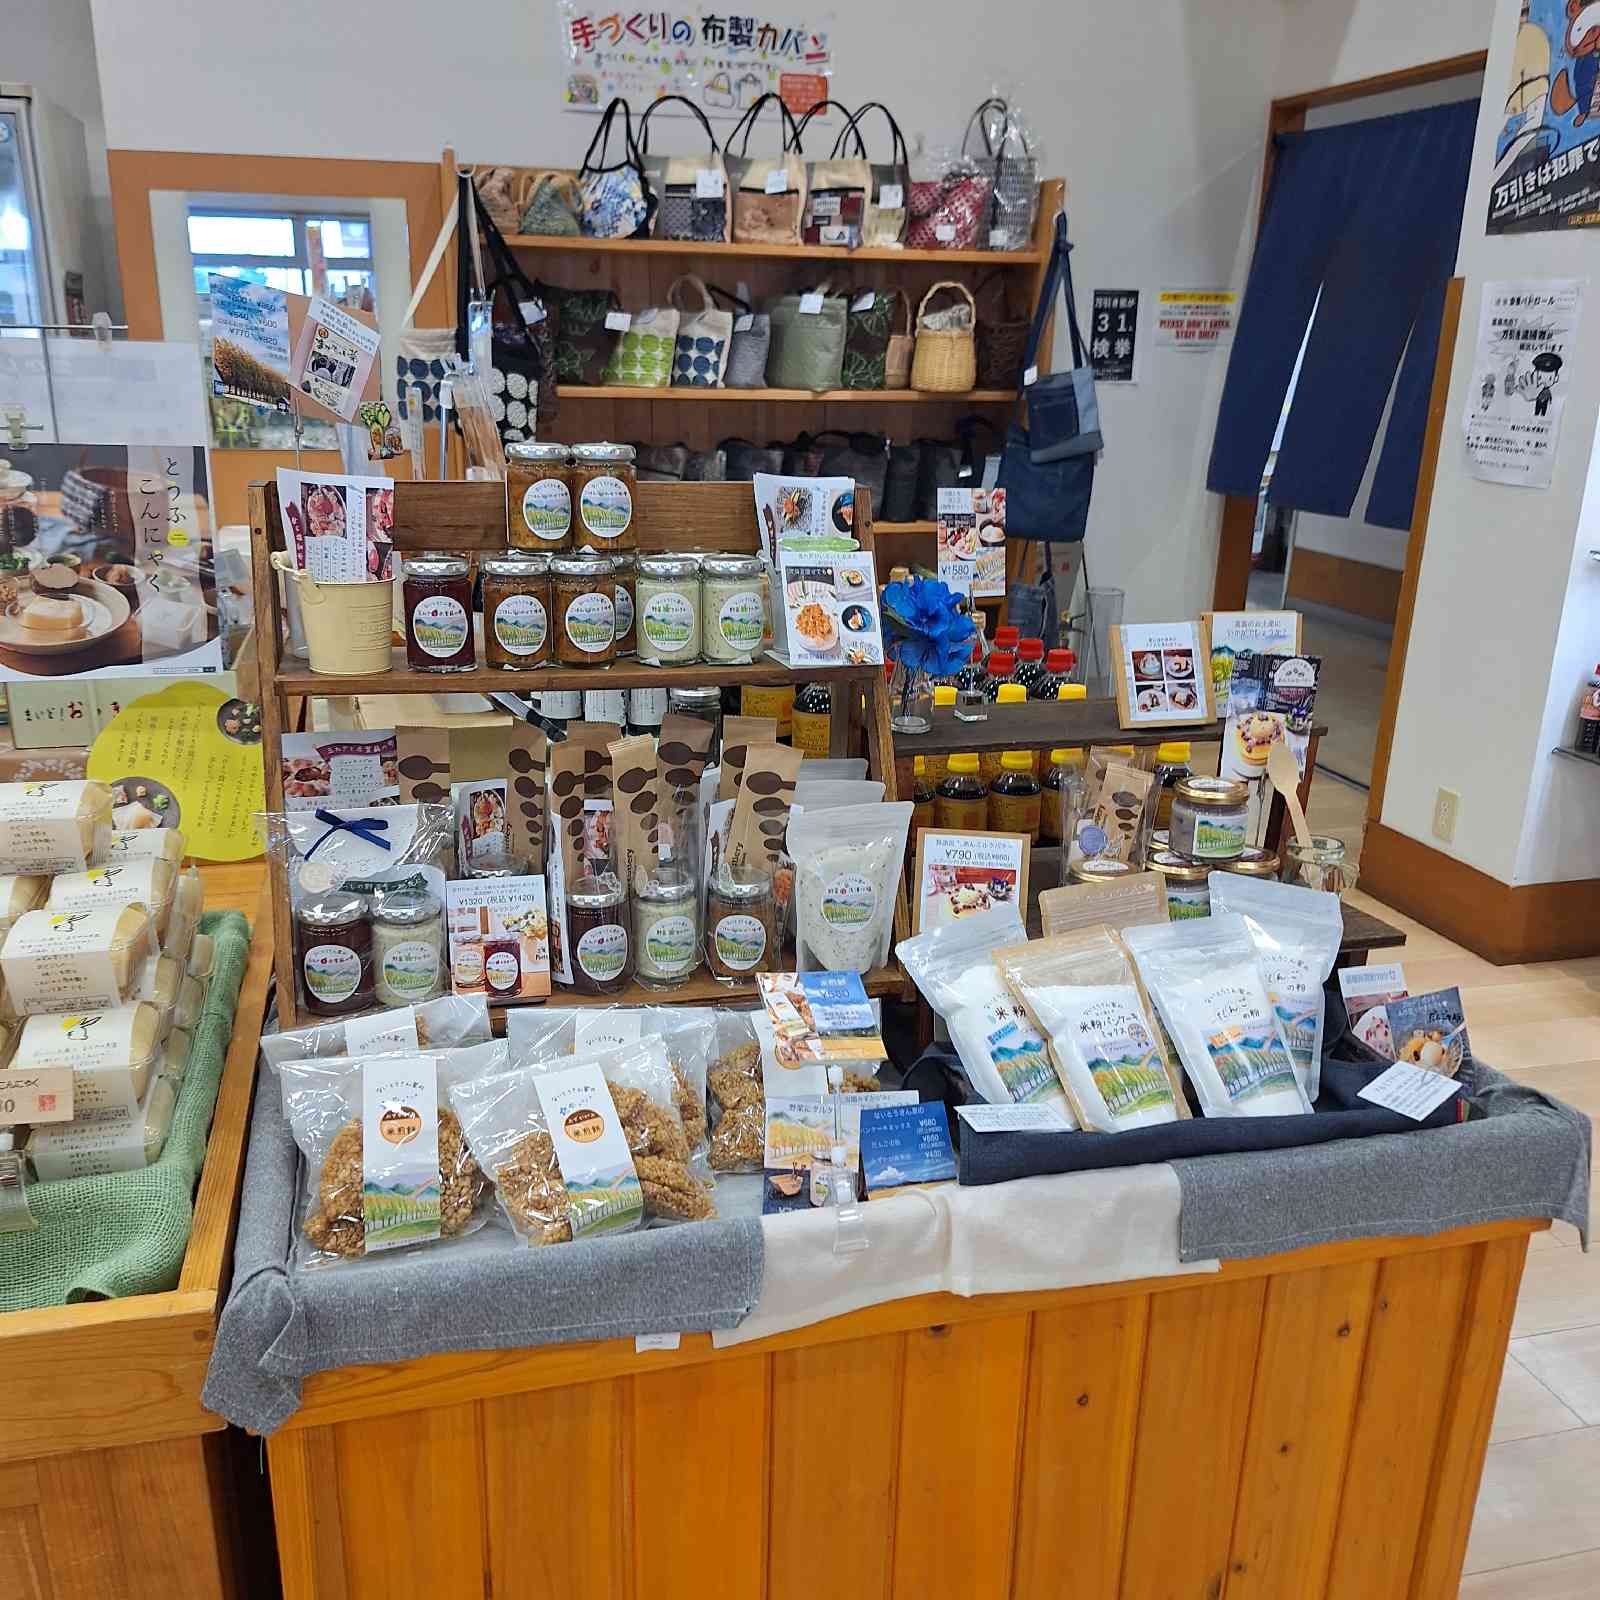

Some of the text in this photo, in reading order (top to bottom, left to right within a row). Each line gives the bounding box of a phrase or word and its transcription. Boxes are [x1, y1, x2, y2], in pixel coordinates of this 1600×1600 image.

[571, 12, 692, 50] 手づくりの
[701, 14, 828, 62] 布製カバン
[1093, 338, 1131, 359] 検挙
[166, 456, 187, 524] とうふ
[139, 478, 165, 593] こんにゃく
[945, 848, 972, 861] ¥790
[994, 1004, 1027, 1021] 米粉
